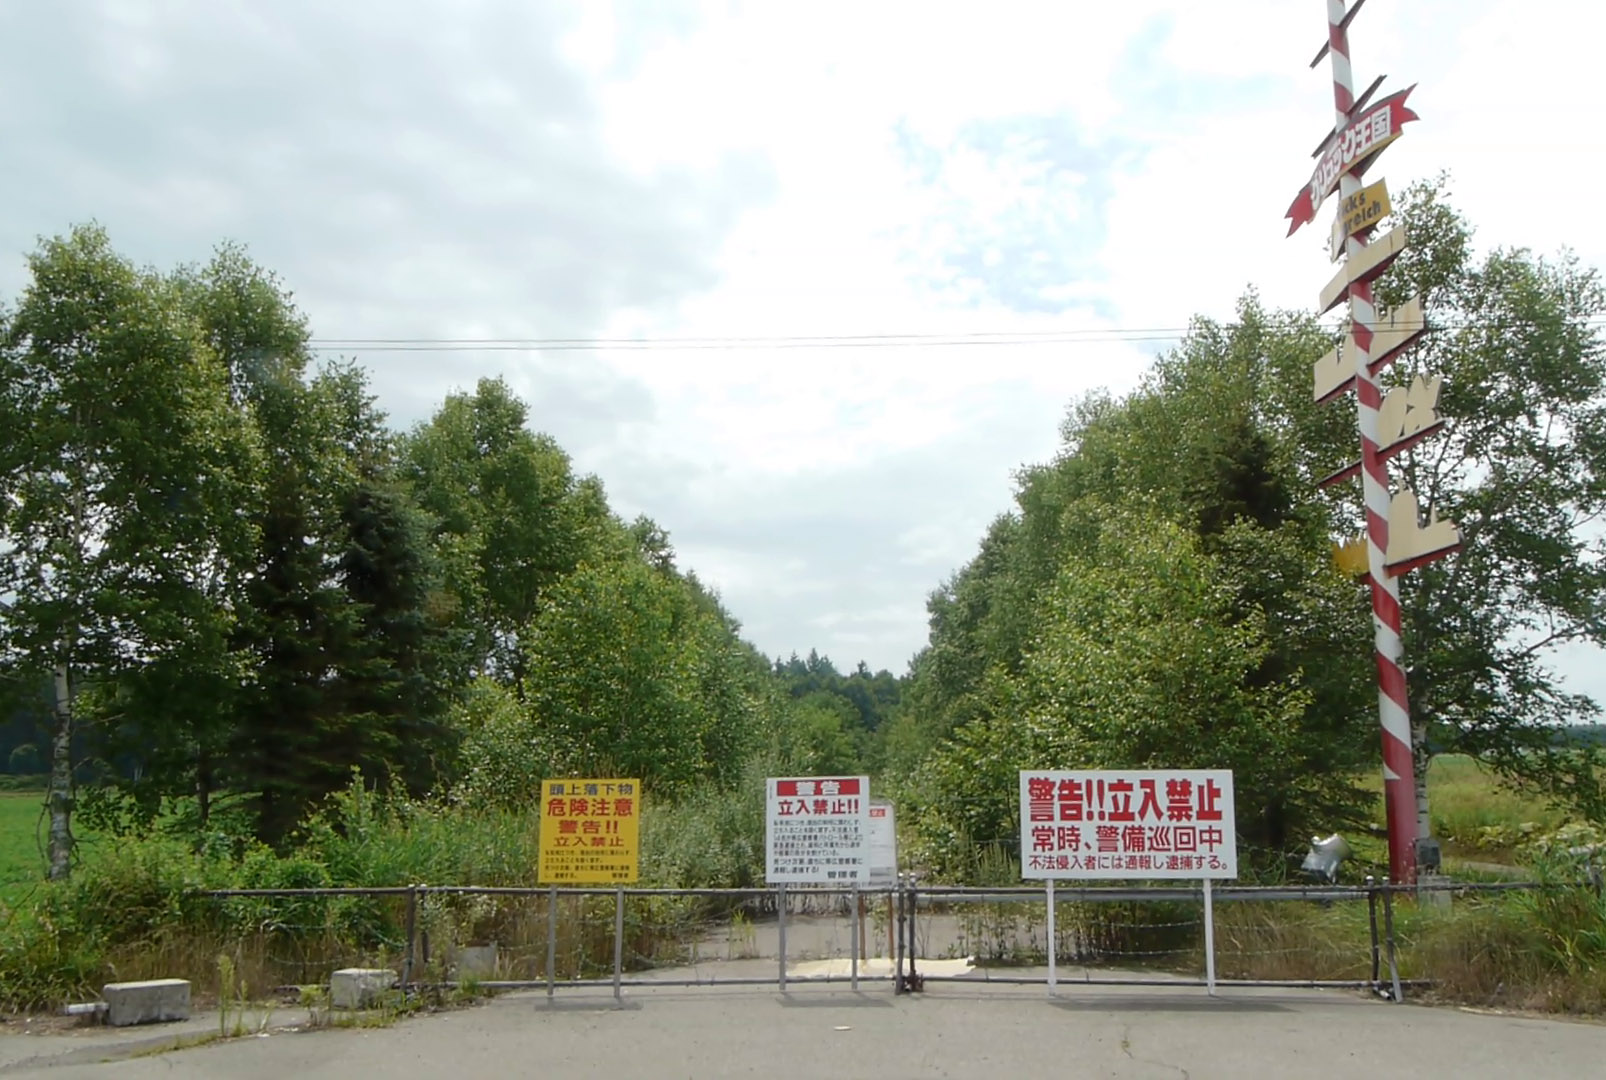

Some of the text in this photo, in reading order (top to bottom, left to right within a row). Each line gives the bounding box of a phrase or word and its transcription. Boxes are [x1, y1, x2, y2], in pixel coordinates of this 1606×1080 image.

[549, 783, 633, 796] 頭上落下物
[796, 781, 840, 796] 警告
[547, 798, 633, 817] 危険注意
[553, 836, 624, 847] 立入禁止
[1031, 825, 1223, 853] 常時、警備巡回中
[1028, 854, 1228, 871] 不法侵入者には通報し逮捕する。
